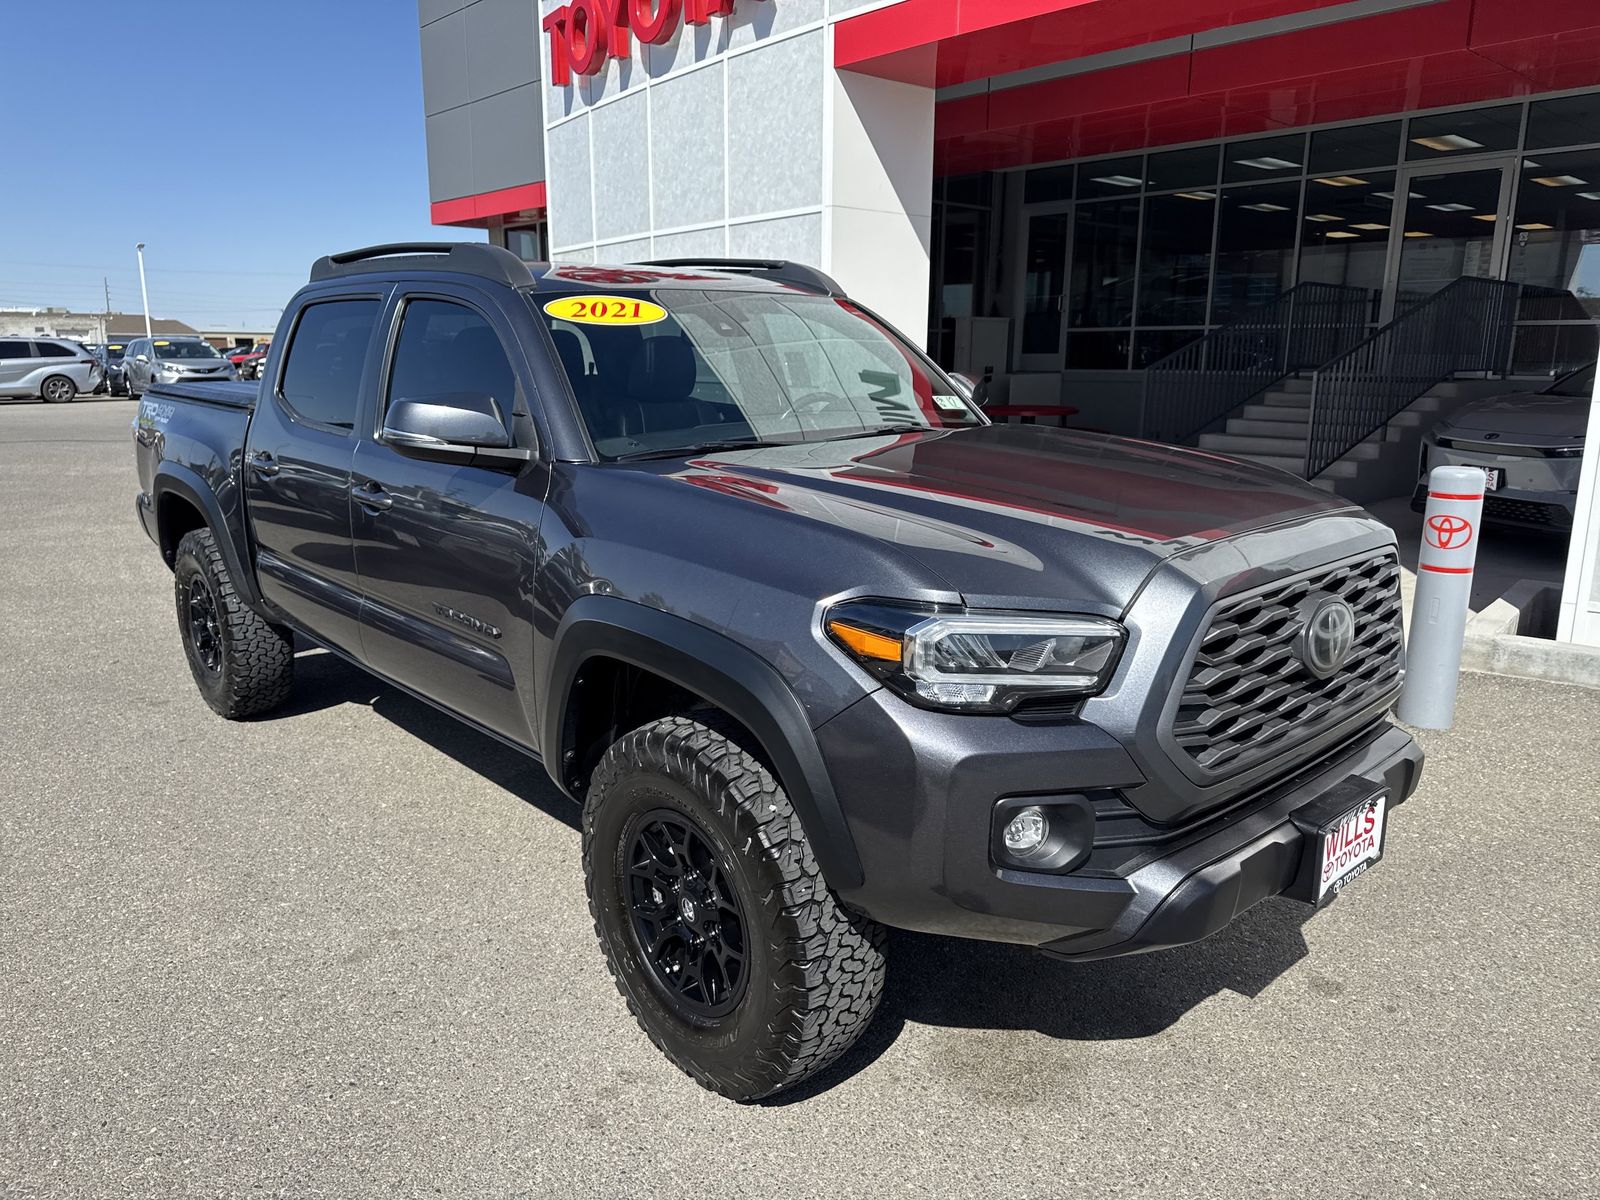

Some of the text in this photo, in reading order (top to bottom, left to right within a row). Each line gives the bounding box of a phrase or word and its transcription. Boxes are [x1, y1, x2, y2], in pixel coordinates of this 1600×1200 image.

[571, 301, 642, 318] 2021
[1326, 805, 1375, 861] WILLS
[1335, 834, 1375, 872] TOYOTA
[1343, 861, 1367, 885] TOYOTA
